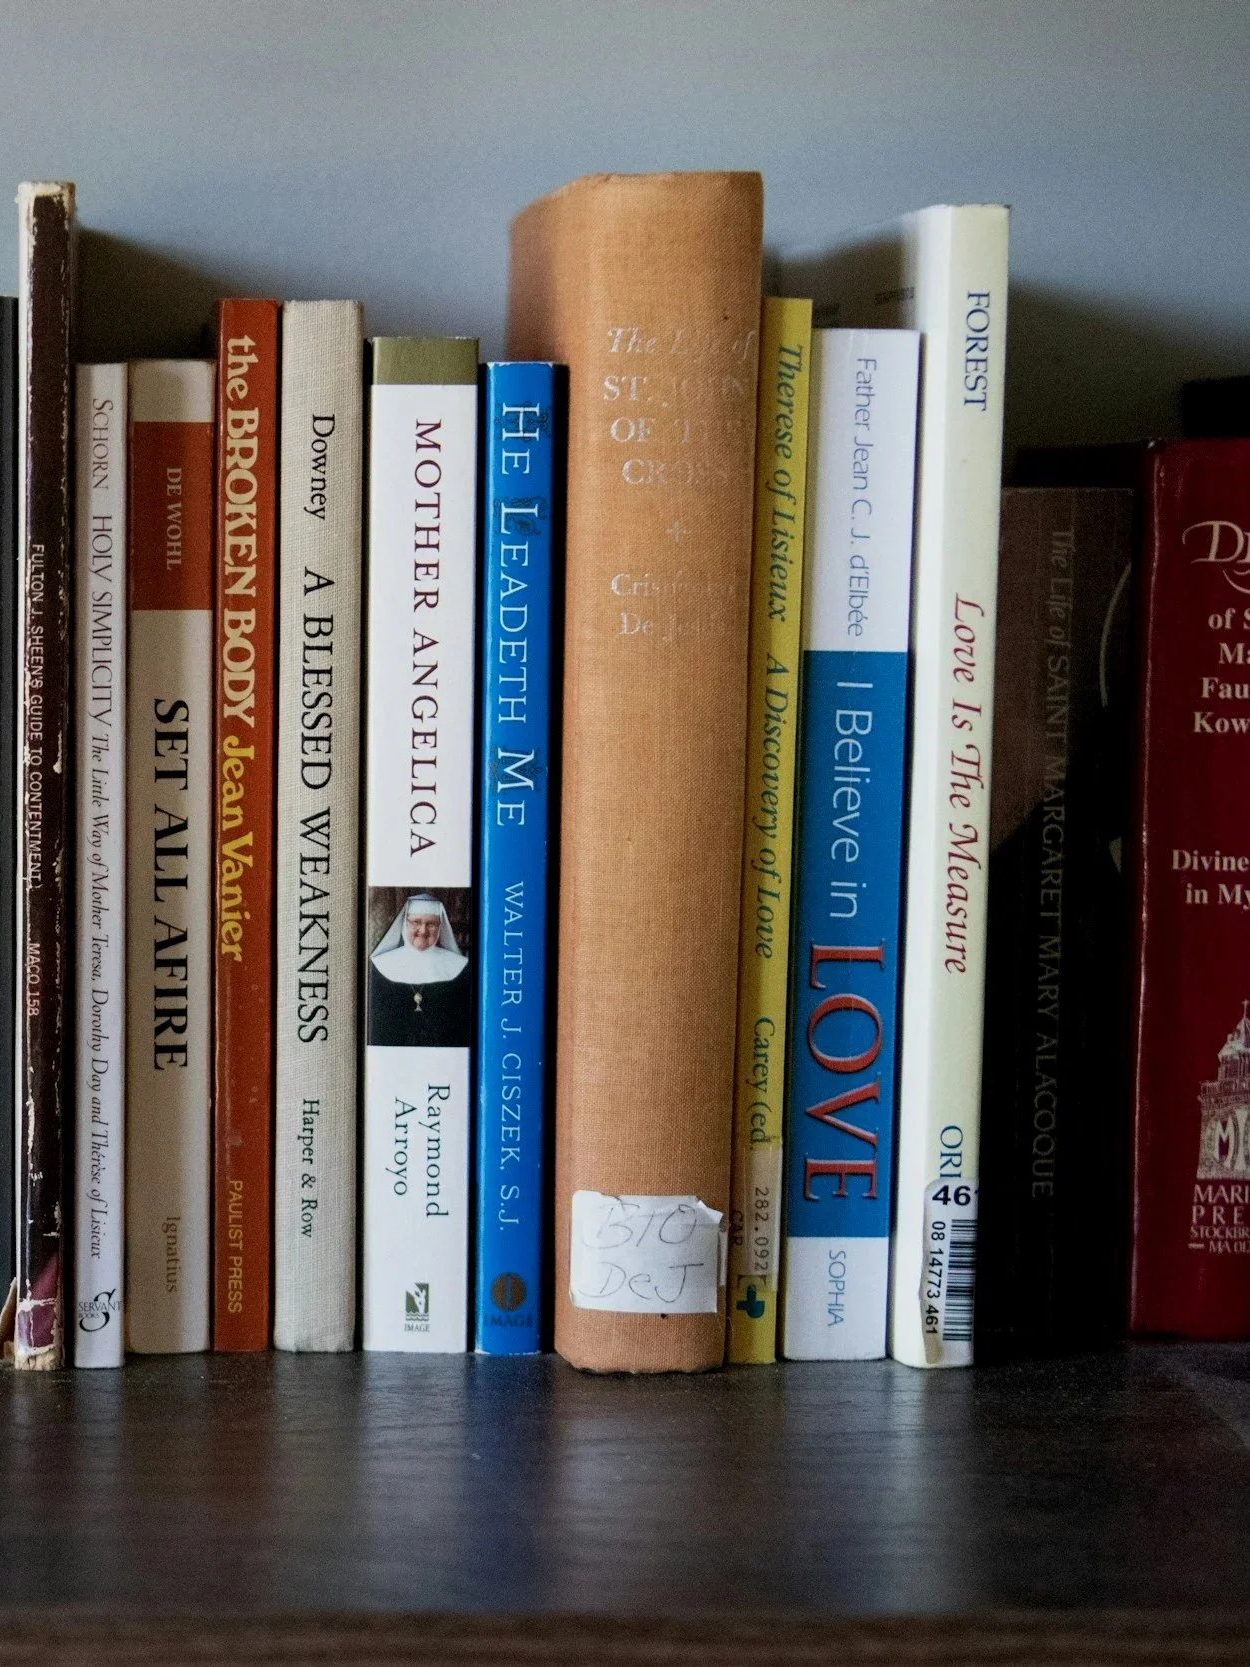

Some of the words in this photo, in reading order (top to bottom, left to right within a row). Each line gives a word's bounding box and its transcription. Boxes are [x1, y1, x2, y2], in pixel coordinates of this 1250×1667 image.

[226, 334, 259, 402] the
[607, 326, 658, 353] The
[963, 290, 991, 413] FOREST
[775, 344, 803, 460] Therese
[854, 357, 878, 431] Father
[91, 398, 114, 490] SCHORN
[303, 413, 336, 521] Downey
[501, 401, 541, 476] HE
[852, 436, 874, 491] Jean
[166, 466, 182, 495] DE
[223, 405, 260, 598] BROKEN
[765, 469, 797, 507] of
[851, 499, 873, 521] C.
[89, 515, 113, 582] HOLY
[166, 500, 182, 572] WOHL
[413, 417, 443, 614] MOTHER
[850, 526, 871, 545] J.
[1050, 528, 1075, 569] The
[30, 543, 45, 603] FULTON
[303, 565, 336, 596] A
[768, 507, 797, 623] Lisieux
[847, 554, 870, 637] d'Elbée
[30, 608, 44, 620] J.
[498, 502, 540, 725] LEADETH
[953, 591, 986, 685] Love
[1207, 607, 1237, 631] of
[29, 624, 45, 689] SHEEN'S
[88, 591, 113, 727] SIMPLICITY
[222, 608, 257, 729] BODY
[766, 653, 789, 676] A
[836, 681, 874, 689] I
[1200, 677, 1250, 700] Fau
[29, 694, 43, 742] GUIDE
[300, 612, 335, 791] BLESSED
[951, 698, 983, 733] Is
[1044, 654, 1070, 745] SAINT
[1192, 711, 1250, 735] Kow
[29, 745, 43, 766] TO
[91, 734, 110, 761] The
[154, 698, 190, 791] SET
[409, 627, 440, 859] ANGELICA
[752, 692, 789, 839] Discovery
[949, 743, 985, 810] The
[91, 768, 110, 808] Little
[221, 735, 255, 832] Jean
[497, 747, 536, 828] ME
[830, 709, 873, 863] Believe
[27, 771, 43, 883] CONTENTMENT
[86, 813, 110, 849] Way
[154, 803, 190, 904] ALL
[1038, 753, 1068, 923] MARGARET
[1172, 848, 1250, 873] Divine
[86, 852, 109, 873] of
[750, 846, 782, 884] of
[1185, 882, 1210, 905] in
[91, 872, 110, 927] Mother
[221, 831, 254, 962] Vanier
[296, 805, 332, 1045] WEAKNESS
[755, 884, 781, 960] Love
[829, 880, 867, 918] in
[944, 822, 982, 975] Measure
[27, 941, 41, 984] MACO
[90, 934, 109, 982] Teresa,
[501, 880, 525, 1008] WALTER
[1036, 933, 1063, 1021] MARY
[27, 987, 40, 1017] 158
[87, 988, 110, 1053] Dorothy
[153, 914, 190, 1071] AFIRE
[500, 1016, 522, 1040] J.
[746, 1017, 776, 1094] Carey
[86, 1058, 109, 1093] Day
[803, 938, 886, 1203] LOVE
[90, 1096, 109, 1127] and
[297, 1097, 320, 1166] Harper
[499, 1052, 523, 1171] CISZEK,
[1030, 1031, 1062, 1200] ALACOQUE
[385, 1097, 418, 1197] Arroyo
[418, 1083, 451, 1219] Raymond
[86, 1187, 108, 1210] of
[300, 1172, 313, 1190] &
[498, 1184, 520, 1232] S.J.
[90, 1207, 109, 1259] Lisieux
[227, 1179, 243, 1251] PAULIST
[299, 1197, 318, 1239] Row
[754, 1187, 770, 1271] 282.092
[930, 1220, 946, 1242] 08
[163, 1215, 181, 1294] Ignatius
[228, 1256, 243, 1315] PRESS
[926, 1249, 945, 1300] 14773
[827, 1249, 847, 1328] SOPHIA
[925, 1303, 940, 1335] 461
[403, 1323, 430, 1333] IMAGE
